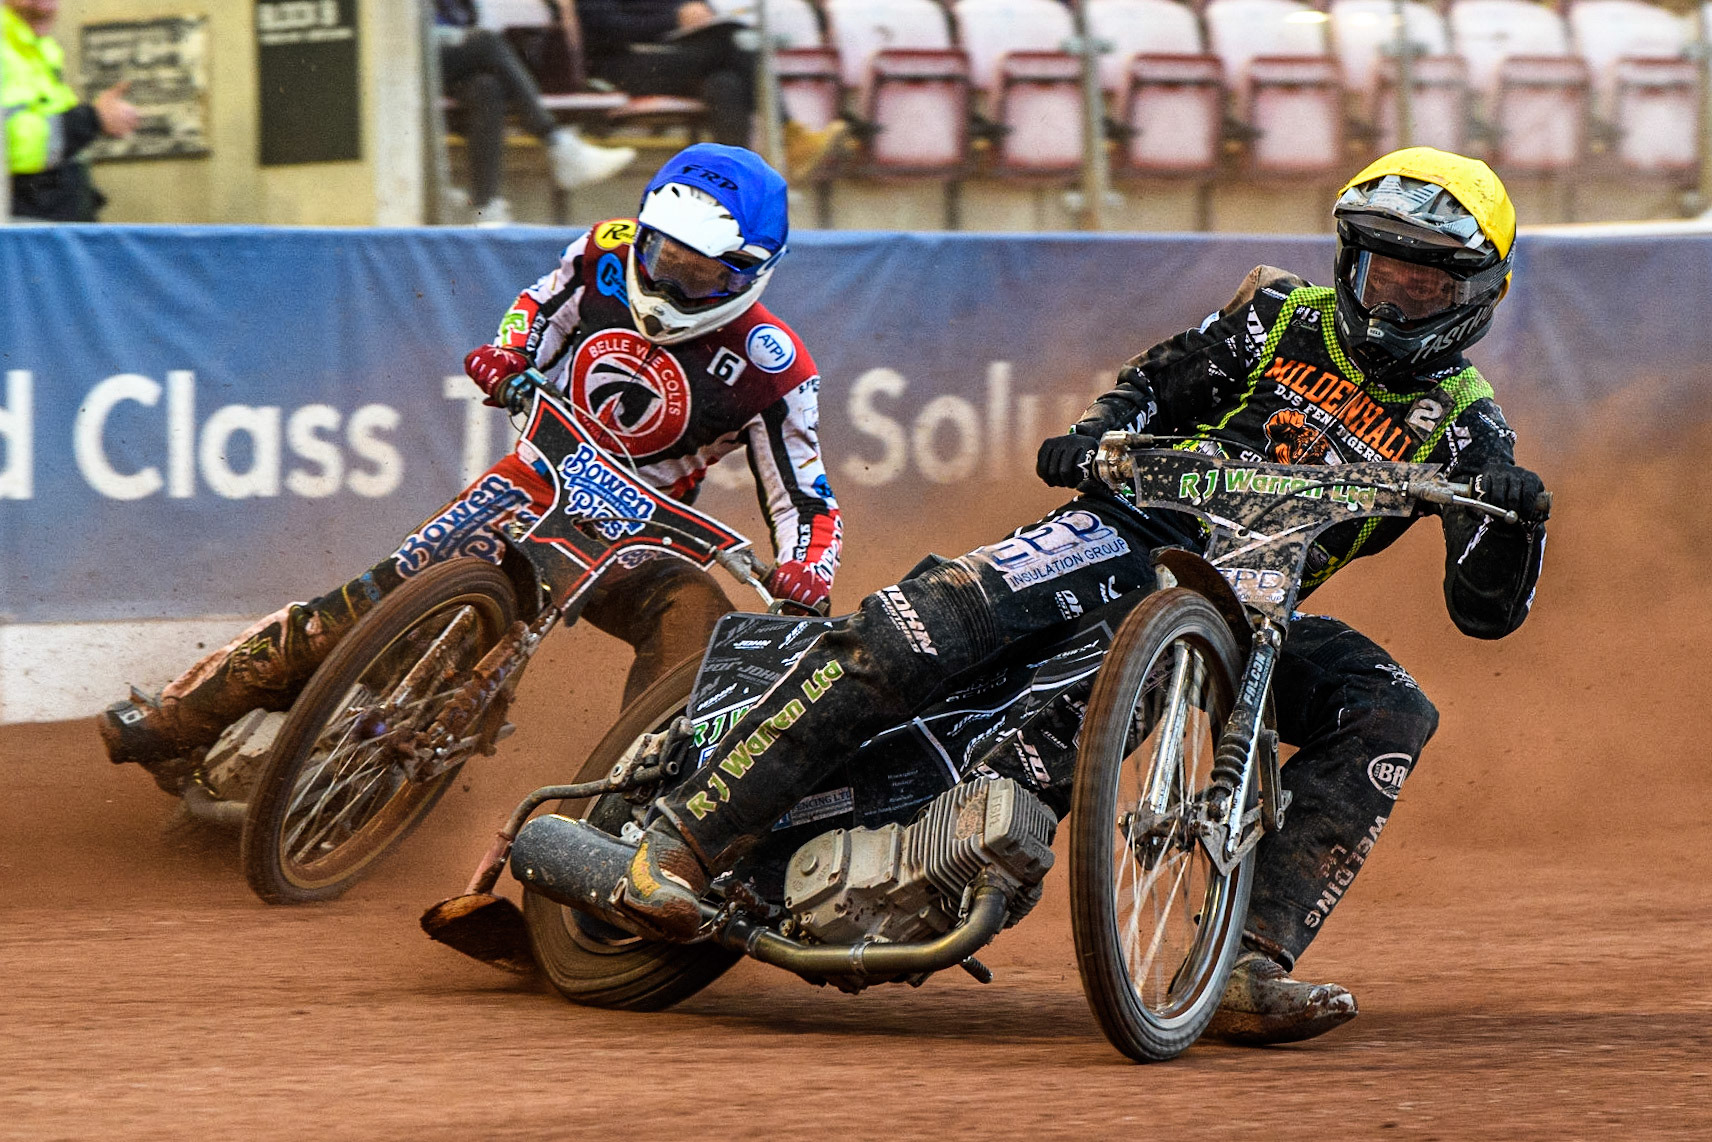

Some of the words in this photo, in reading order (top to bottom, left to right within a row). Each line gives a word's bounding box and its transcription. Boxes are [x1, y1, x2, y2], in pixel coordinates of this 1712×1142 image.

[588, 338, 631, 358] BELLE
[661, 369, 681, 416] COLTS
[713, 352, 740, 381] 6
[757, 334, 785, 362] ATPI
[73, 370, 402, 499] Class
[1274, 384, 1303, 406] DJS
[1303, 404, 1333, 428] FEN
[1336, 423, 1383, 463] TIGERS
[1408, 399, 1443, 432] 2
[562, 444, 655, 520] Bowen
[1225, 468, 1325, 499] Warren
[397, 474, 511, 577] Bowen
[1009, 552, 1084, 588] INSULATION
[1084, 539, 1127, 560] GROUP
[1243, 652, 1266, 706] FALCON
[686, 791, 717, 820] R
[801, 659, 845, 704] Ltd
